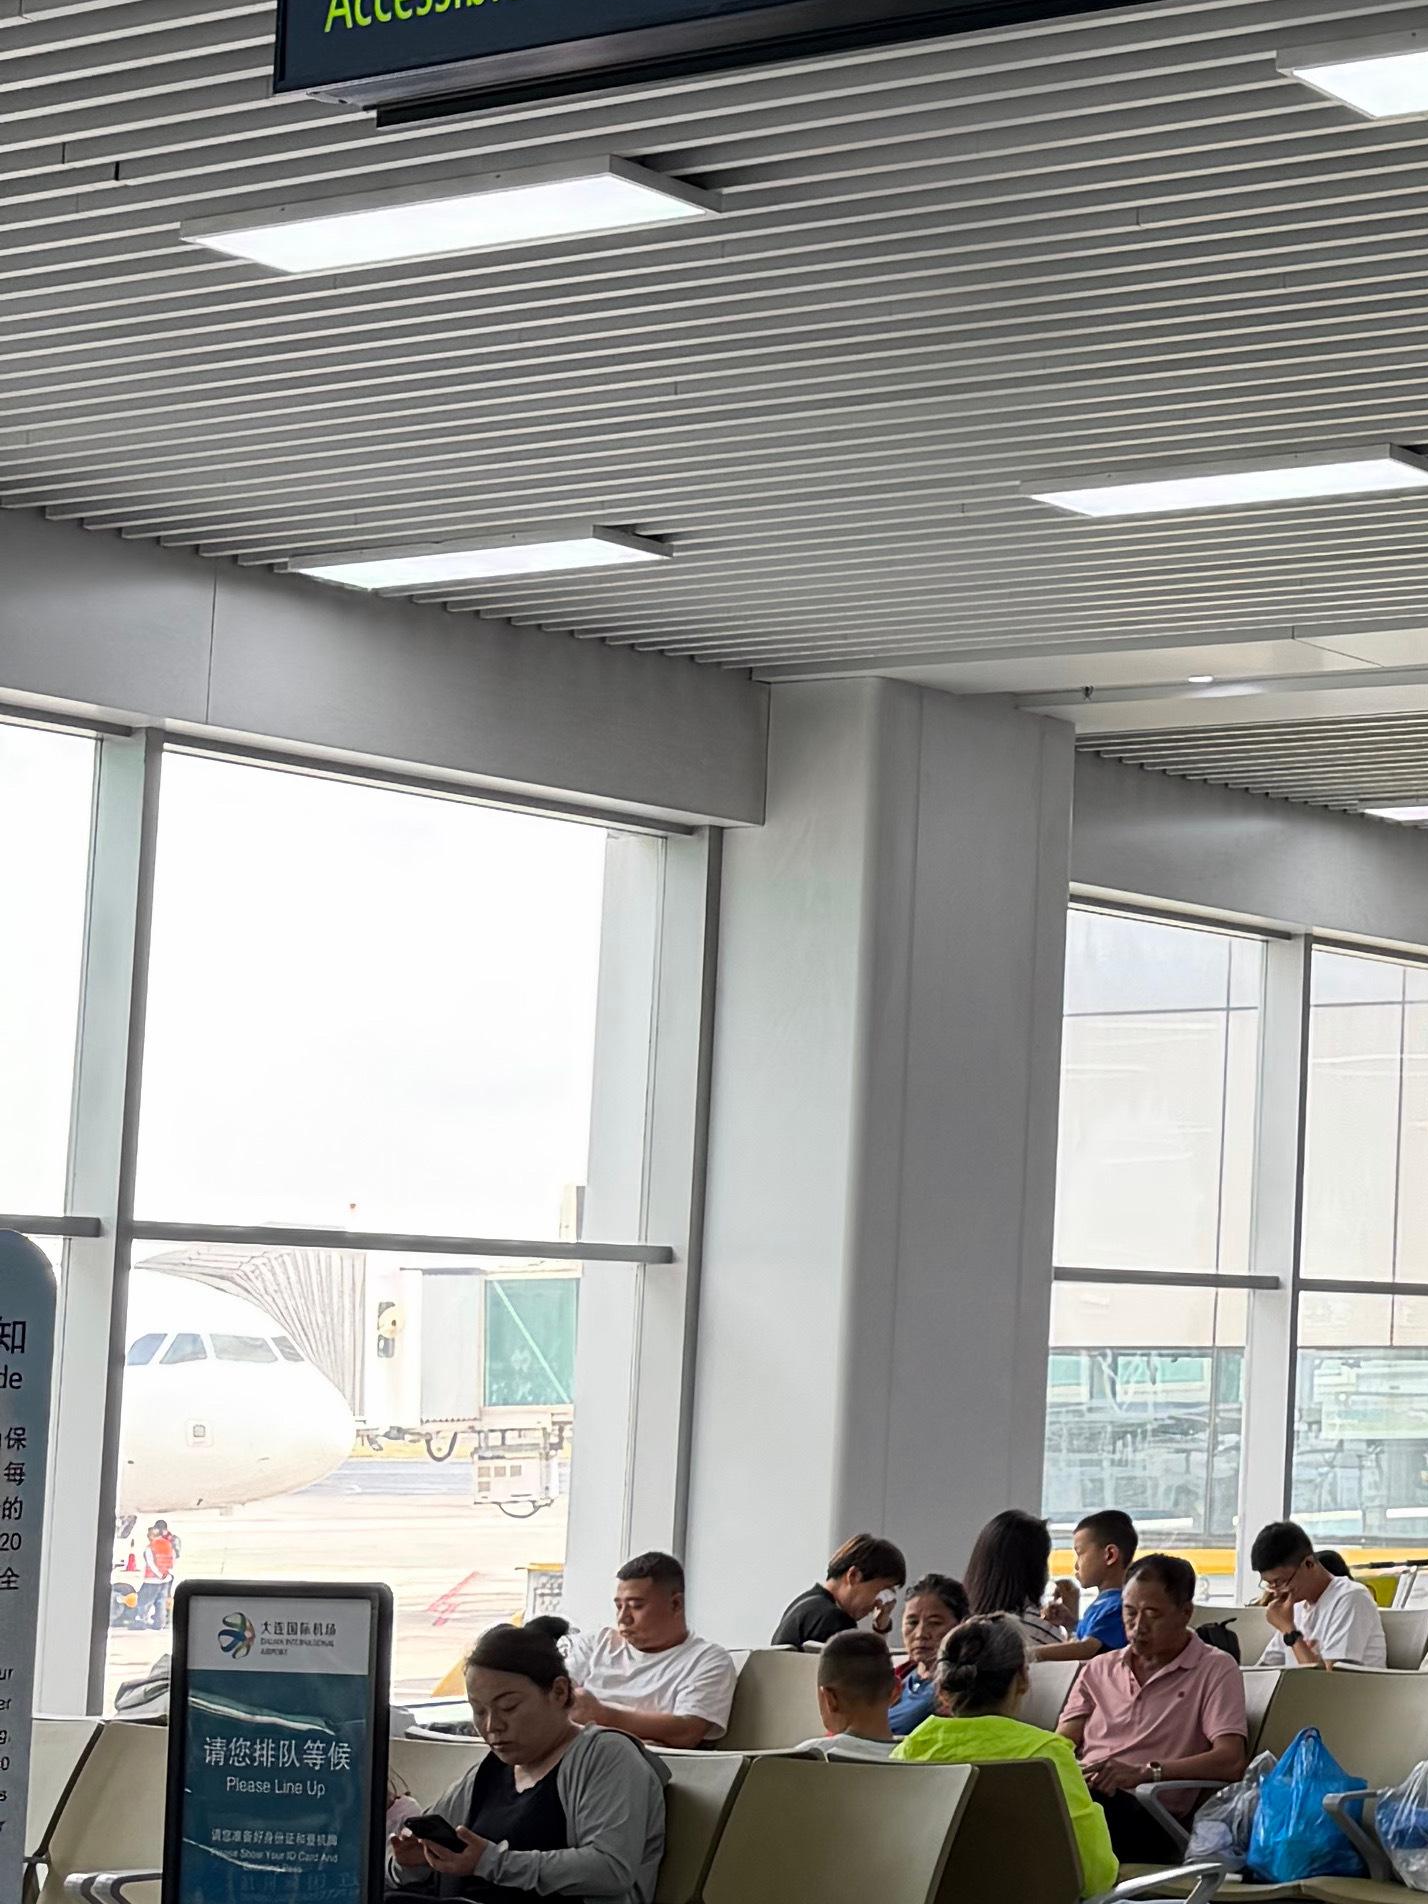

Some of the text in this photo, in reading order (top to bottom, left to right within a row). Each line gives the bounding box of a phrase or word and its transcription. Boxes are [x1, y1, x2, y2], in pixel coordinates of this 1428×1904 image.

[260, 1621, 337, 1637] 大连国际机场
[203, 1737, 352, 1771] 请您排队等候
[226, 1777, 326, 1798] Please Line Up
